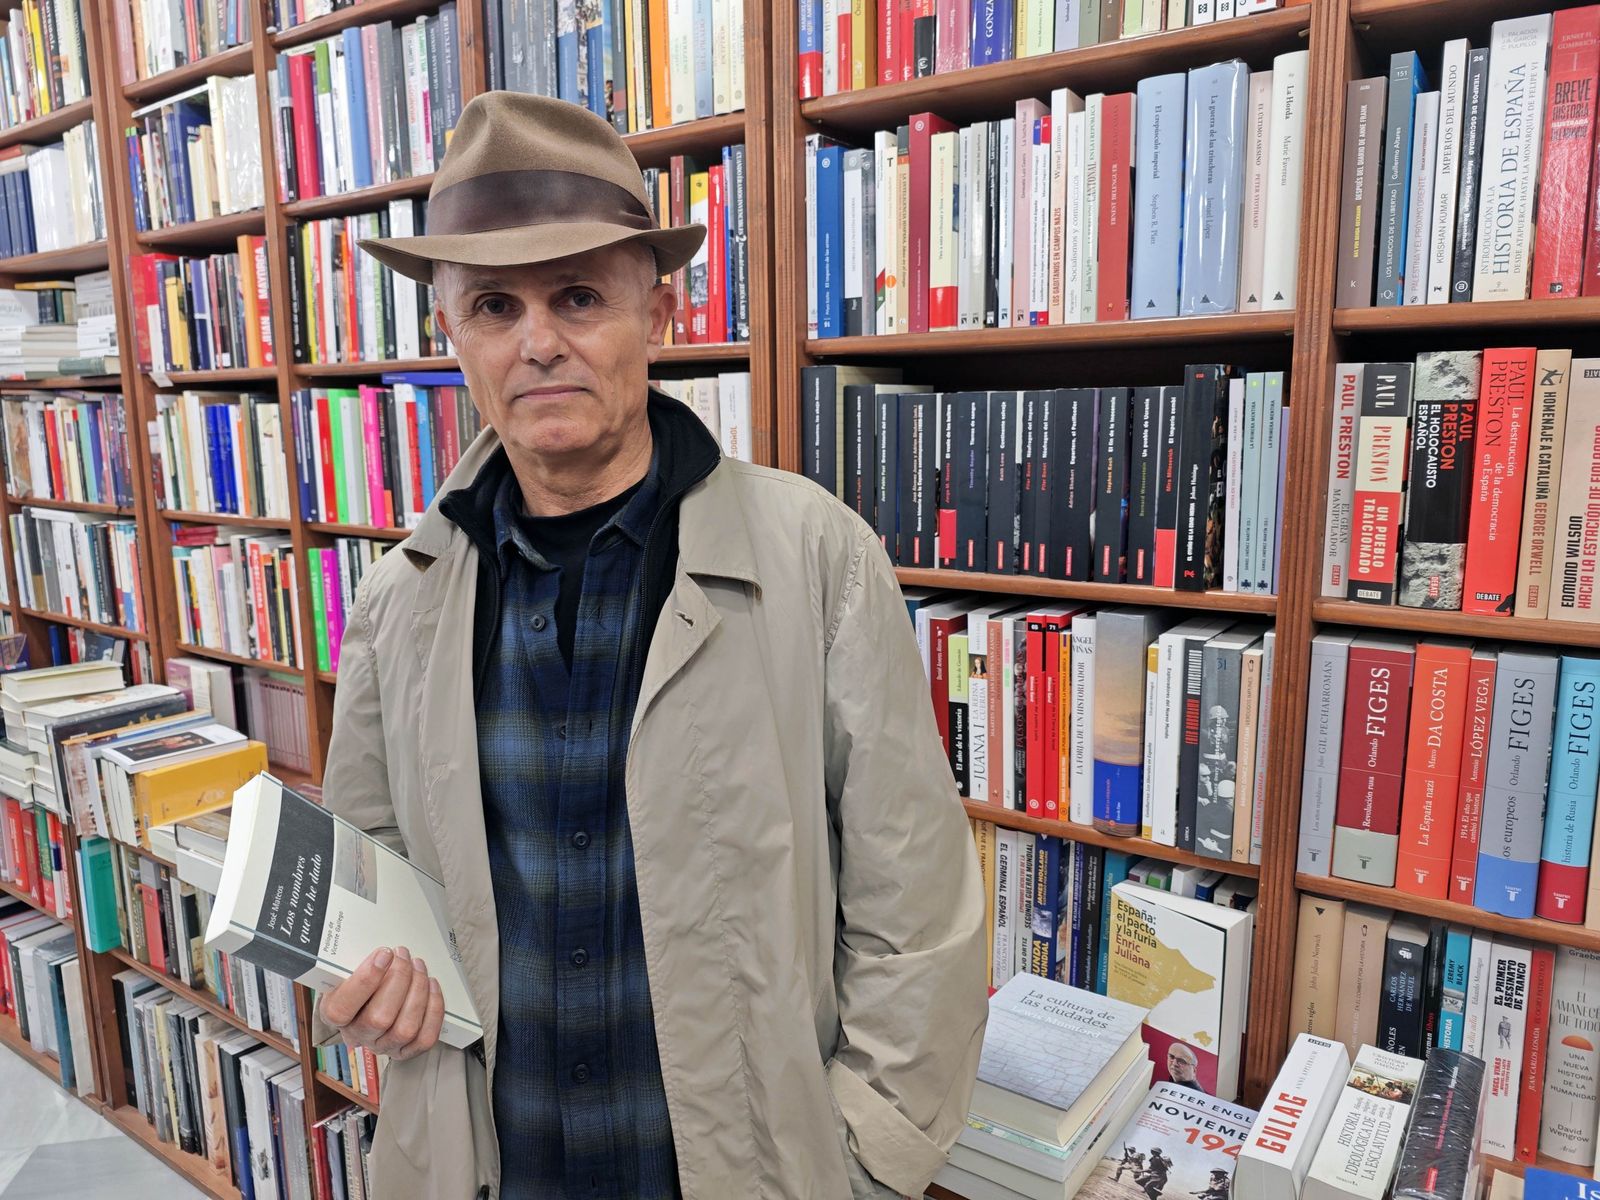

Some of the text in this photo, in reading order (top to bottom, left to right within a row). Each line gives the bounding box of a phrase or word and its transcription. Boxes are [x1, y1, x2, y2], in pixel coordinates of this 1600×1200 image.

[1210, 95, 1218, 104] La
[1285, 85, 1295, 120] La Horda
[1468, 73, 1480, 156] TIEMPOS DE OSCURIDAD
[1504, 63, 1526, 140] ESPAÑA
[1554, 78, 1592, 105] BREVE
[1208, 106, 1217, 130] guerra
[1442, 65, 1457, 174] IMPERIOS DEL MUNDO
[1151, 105, 1161, 179] El crepúsculo imperial
[1208, 139, 1216, 148] las
[1391, 150, 1400, 180] Guillermo
[1500, 145, 1519, 173] DE
[1207, 150, 1216, 184] trincheras
[1437, 193, 1448, 264] KRISHAN KUMAR
[1492, 178, 1517, 275] HISTORIA
[1375, 374, 1397, 408] PAUL
[1485, 360, 1508, 448] PRESTON
[1507, 360, 1528, 406] PAUL
[1336, 374, 1356, 479] PAUL PRESTON
[1415, 403, 1428, 451] ESPAÑOL
[1440, 403, 1459, 470] PRESTON
[1459, 403, 1475, 442] PAUL
[1541, 391, 1557, 442] HOMENAJE
[1369, 425, 1392, 482] PRESTON
[1425, 404, 1441, 489] EL HOLOCAUSTO
[1506, 407, 1523, 477] La destrucción
[1480, 454, 1492, 502] en España
[1536, 453, 1551, 500] CATALUÑA
[1329, 488, 1341, 557] MANIPULADOR
[1339, 502, 1350, 544] EL GRAN
[1489, 462, 1505, 541] de la democracia
[1358, 498, 1377, 574] TRAICIONADO
[1373, 506, 1389, 568] UN PUEBLO
[1529, 502, 1548, 575] GEORGE ORWELL
[1561, 515, 1582, 607] EDMUND WILSON
[1581, 559, 1596, 572] LA
[1476, 593, 1500, 601] DEBATE
[1577, 575, 1594, 609] HACIA
[1318, 660, 1332, 754] GIL PECHARROMÁN
[1366, 667, 1391, 768] Orlando FIGES
[1433, 667, 1449, 721] COSTA
[955, 708, 963, 732] victoria
[956, 732, 963, 740] la
[1428, 723, 1442, 749] DA
[1470, 676, 1489, 782] Antonio LÓPEZ VEGA
[1507, 677, 1535, 786] Orlando FIGES
[1567, 681, 1595, 789] Orlando FIGES
[956, 741, 963, 749] de
[956, 763, 963, 771] El
[973, 731, 987, 780] JUANA
[1362, 776, 1375, 827] Revolución rusa
[1418, 780, 1435, 846] La España nazi
[1562, 800, 1577, 864] historia de Rusia
[268, 885, 284, 930] José Mateos
[280, 855, 306, 938] Los nombres
[299, 854, 322, 944] que te he dado
[998, 842, 1008, 928] EL GERMINAL ESPAÑOL
[1116, 912, 1156, 936] el pacto
[1116, 923, 1157, 949] y la furia
[1117, 899, 1157, 926] España:
[1114, 946, 1151, 969] Juliana
[1116, 934, 1141, 953] Enric
[1397, 971, 1407, 1012] HERNÁNDEZ
[1405, 976, 1415, 1012] DE MIGUEL
[1456, 964, 1464, 986] BLACK
[1494, 959, 1507, 1006] EL PRIMER
[1503, 960, 1516, 1009] ASESINATO
[1513, 962, 1527, 1011] DE FRANCO
[1020, 995, 1109, 1029] las ciudades
[1028, 989, 1116, 1021] La cultura de
[1557, 1070, 1593, 1082] HISTORIA
[1563, 1061, 1589, 1071] NUEVA
[1568, 1052, 1586, 1061] UNA
[1159, 1088, 1253, 1124] PETER ENGL
[1550, 1084, 1597, 1102] HUMANIDAD
[1562, 1080, 1575, 1089] DE
[1256, 1092, 1308, 1154] GULAG
[1337, 1110, 1361, 1147] HISTORIA
[1345, 1114, 1377, 1176] IDEOLÓGICA DE
[1549, 1126, 1589, 1143] Wengrow
[1558, 1124, 1582, 1136] David
[1361, 1117, 1391, 1181] LA ESCLAVITUD
